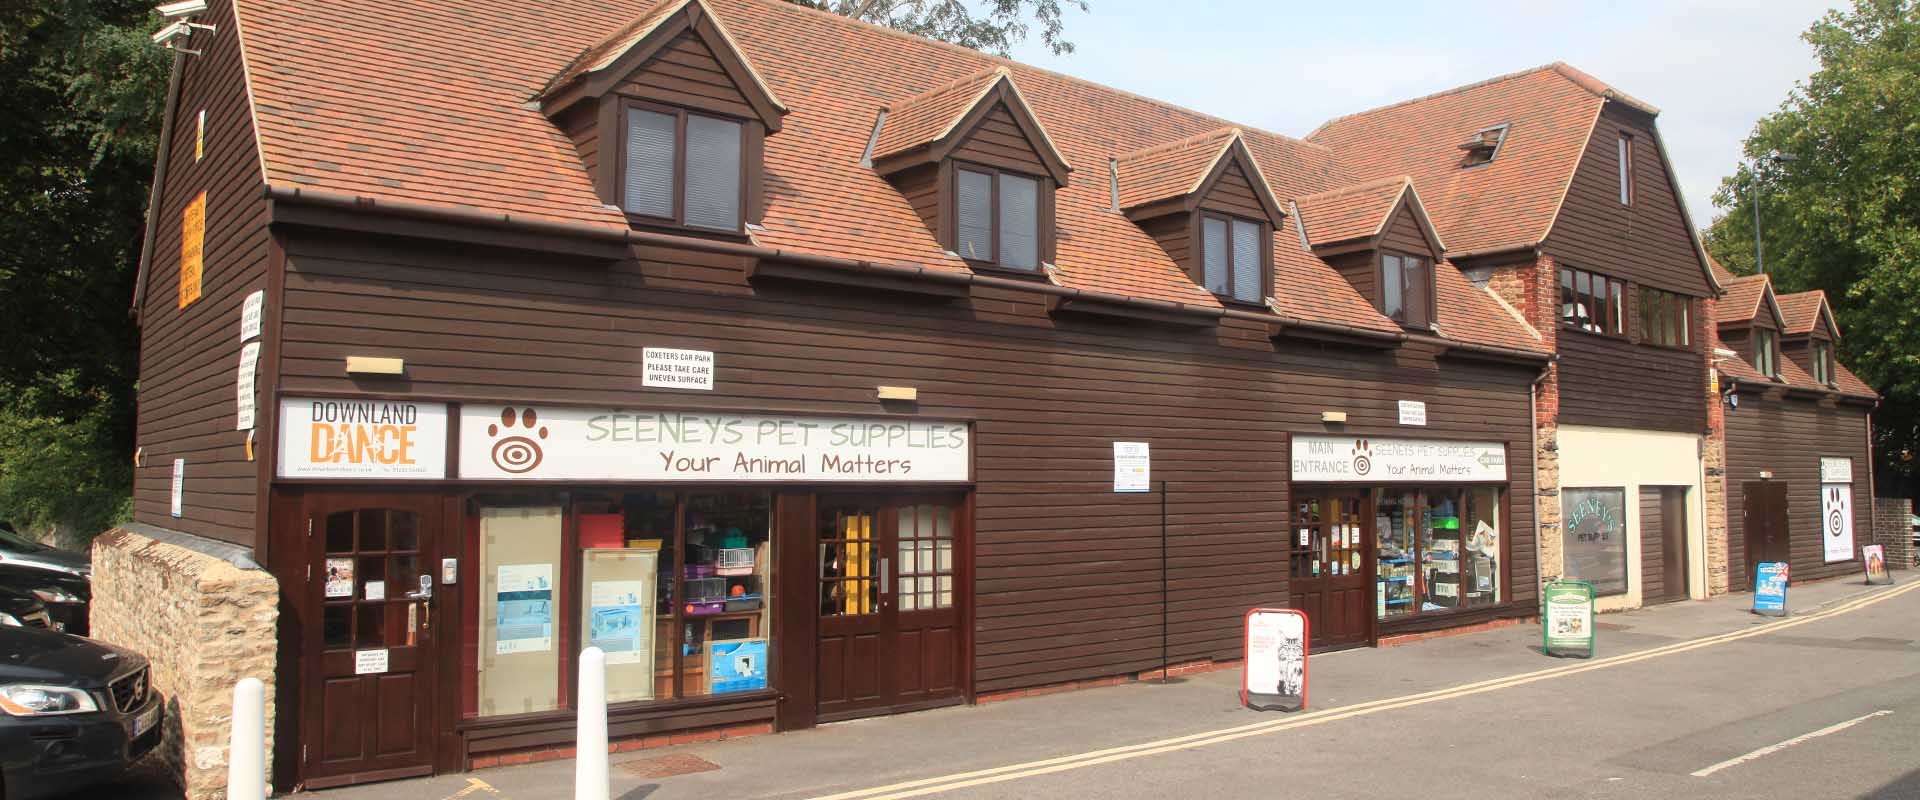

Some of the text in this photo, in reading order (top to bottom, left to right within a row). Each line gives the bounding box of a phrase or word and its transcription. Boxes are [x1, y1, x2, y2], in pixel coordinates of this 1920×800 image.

[646, 350, 711, 362] COXETERS CAR PARK
[647, 363, 710, 374] PLEASE TAKE CARE
[649, 374, 707, 384] UNEVEN SURFACE
[312, 401, 417, 425] DOWNLAND
[586, 412, 965, 449] SEENEYS PET SUPPLIES
[310, 423, 417, 465] DANCE
[1308, 439, 1334, 455] MAIN
[1417, 445, 1435, 457] PET
[660, 450, 912, 475] Your Animal Matters
[1293, 459, 1350, 473] ENTRANCE
[1386, 463, 1472, 475] Your Animal Matters
